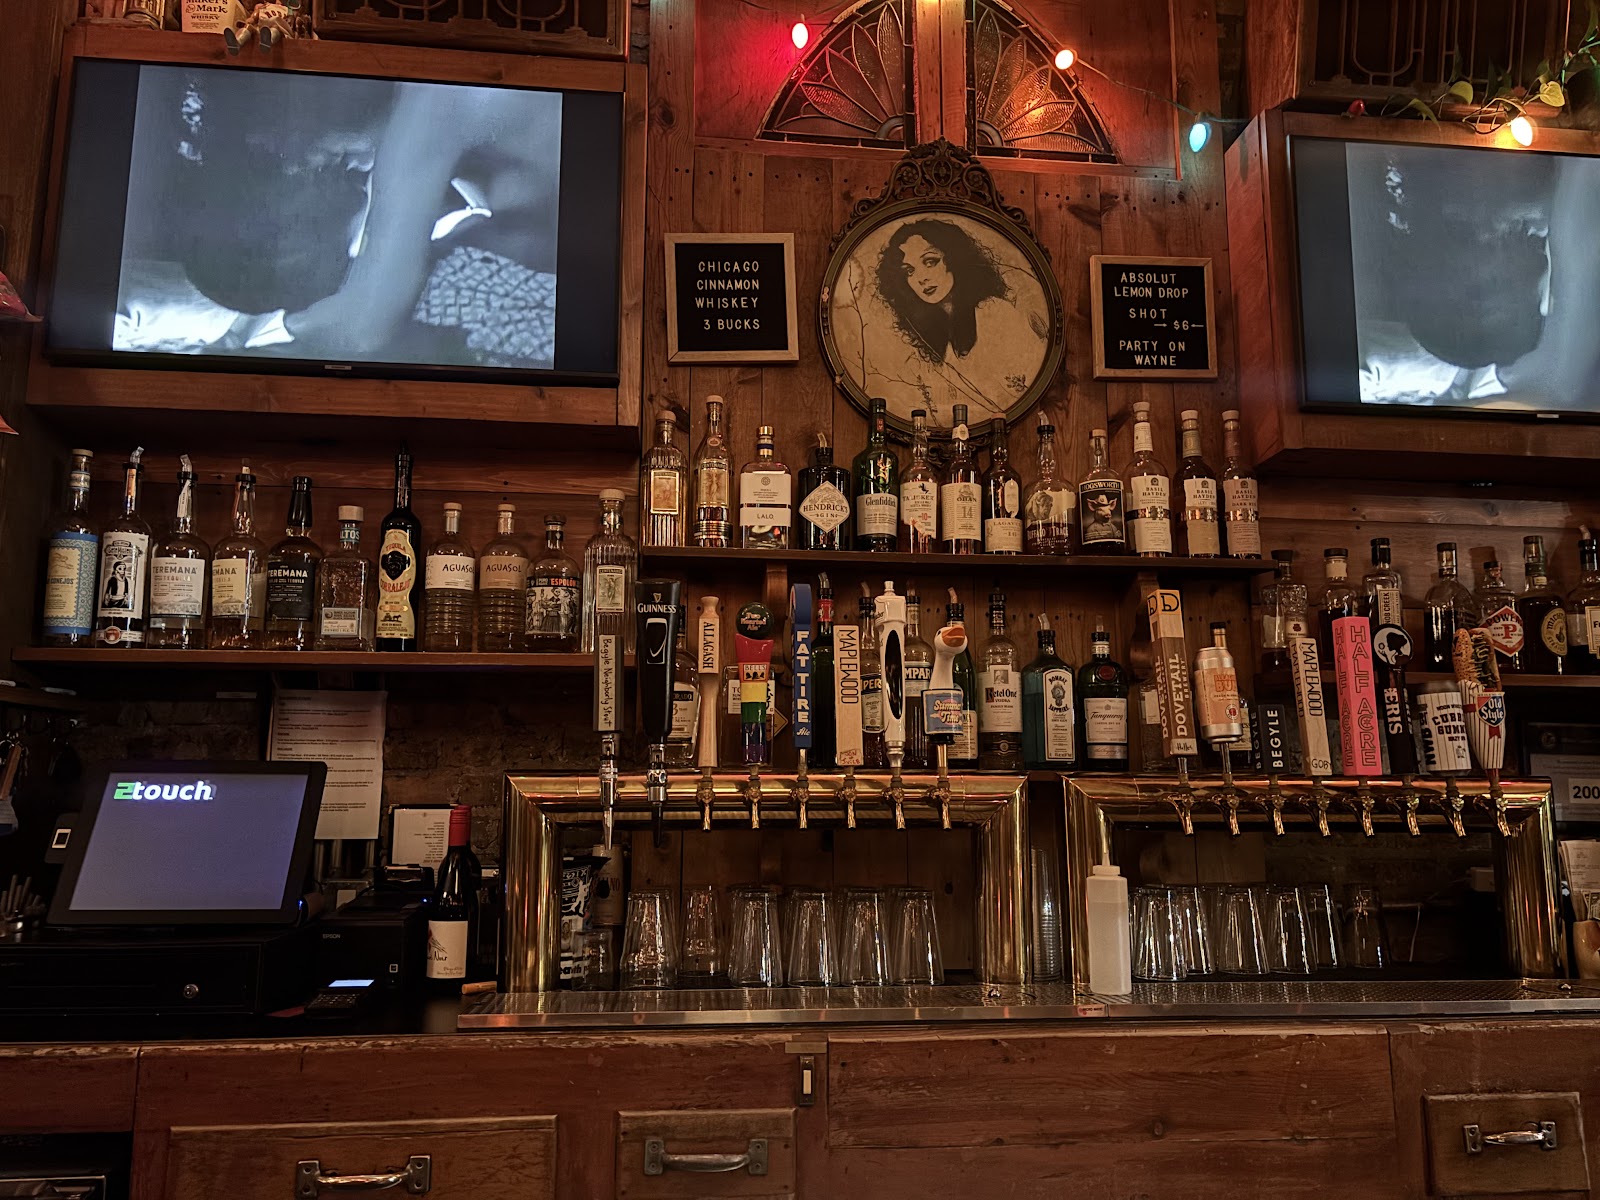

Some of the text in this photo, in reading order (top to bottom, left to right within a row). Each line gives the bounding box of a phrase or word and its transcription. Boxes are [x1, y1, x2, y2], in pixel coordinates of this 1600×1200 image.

[196, 5, 228, 13] Mark
[698, 260, 760, 273] CHICAGO
[1120, 272, 1177, 284] ABSOLUT
[696, 279, 760, 291] CINNAMON
[1113, 286, 1189, 299] LEMON DROP
[695, 297, 759, 310] WHISKEY
[1128, 308, 1168, 319] SHOT
[703, 318, 760, 331] 3 BUCKS
[1173, 320, 1190, 331] $6
[1119, 340, 1186, 352] PARTY ON
[1134, 355, 1177, 367] WAYNE
[865, 496, 896, 507] Glenfiddich
[803, 503, 848, 514] HENDRICK'S
[962, 506, 973, 518] 14
[152, 566, 196, 574] TEREMANA
[486, 563, 521, 573] AGUASOL
[637, 603, 677, 614] GUINNESS
[1501, 623, 1517, 640] P
[703, 621, 715, 669] ALLAGASH
[838, 629, 859, 704] MAPLEWOOD
[796, 630, 810, 723] FAT TIRE
[1048, 675, 1067, 685] BOMBAY
[1291, 643, 1304, 718] MAPLEWOOD
[1301, 641, 1323, 717] MAPLEWOOD
[986, 687, 1017, 702] Ketel One
[1168, 653, 1188, 737] DOVETAIL
[1334, 626, 1354, 767] HALF ACRE
[1350, 625, 1377, 767] HALF ACRE
[1487, 697, 1502, 710] Old
[603, 706, 613, 727] Stout
[1090, 711, 1124, 721] Tanqueray
[1384, 687, 1403, 735] ERIS
[1479, 706, 1504, 724] Style
[1431, 712, 1464, 726] CUBB
[1250, 711, 1262, 770] BEGYLE
[1266, 709, 1284, 768] BEGYLE
